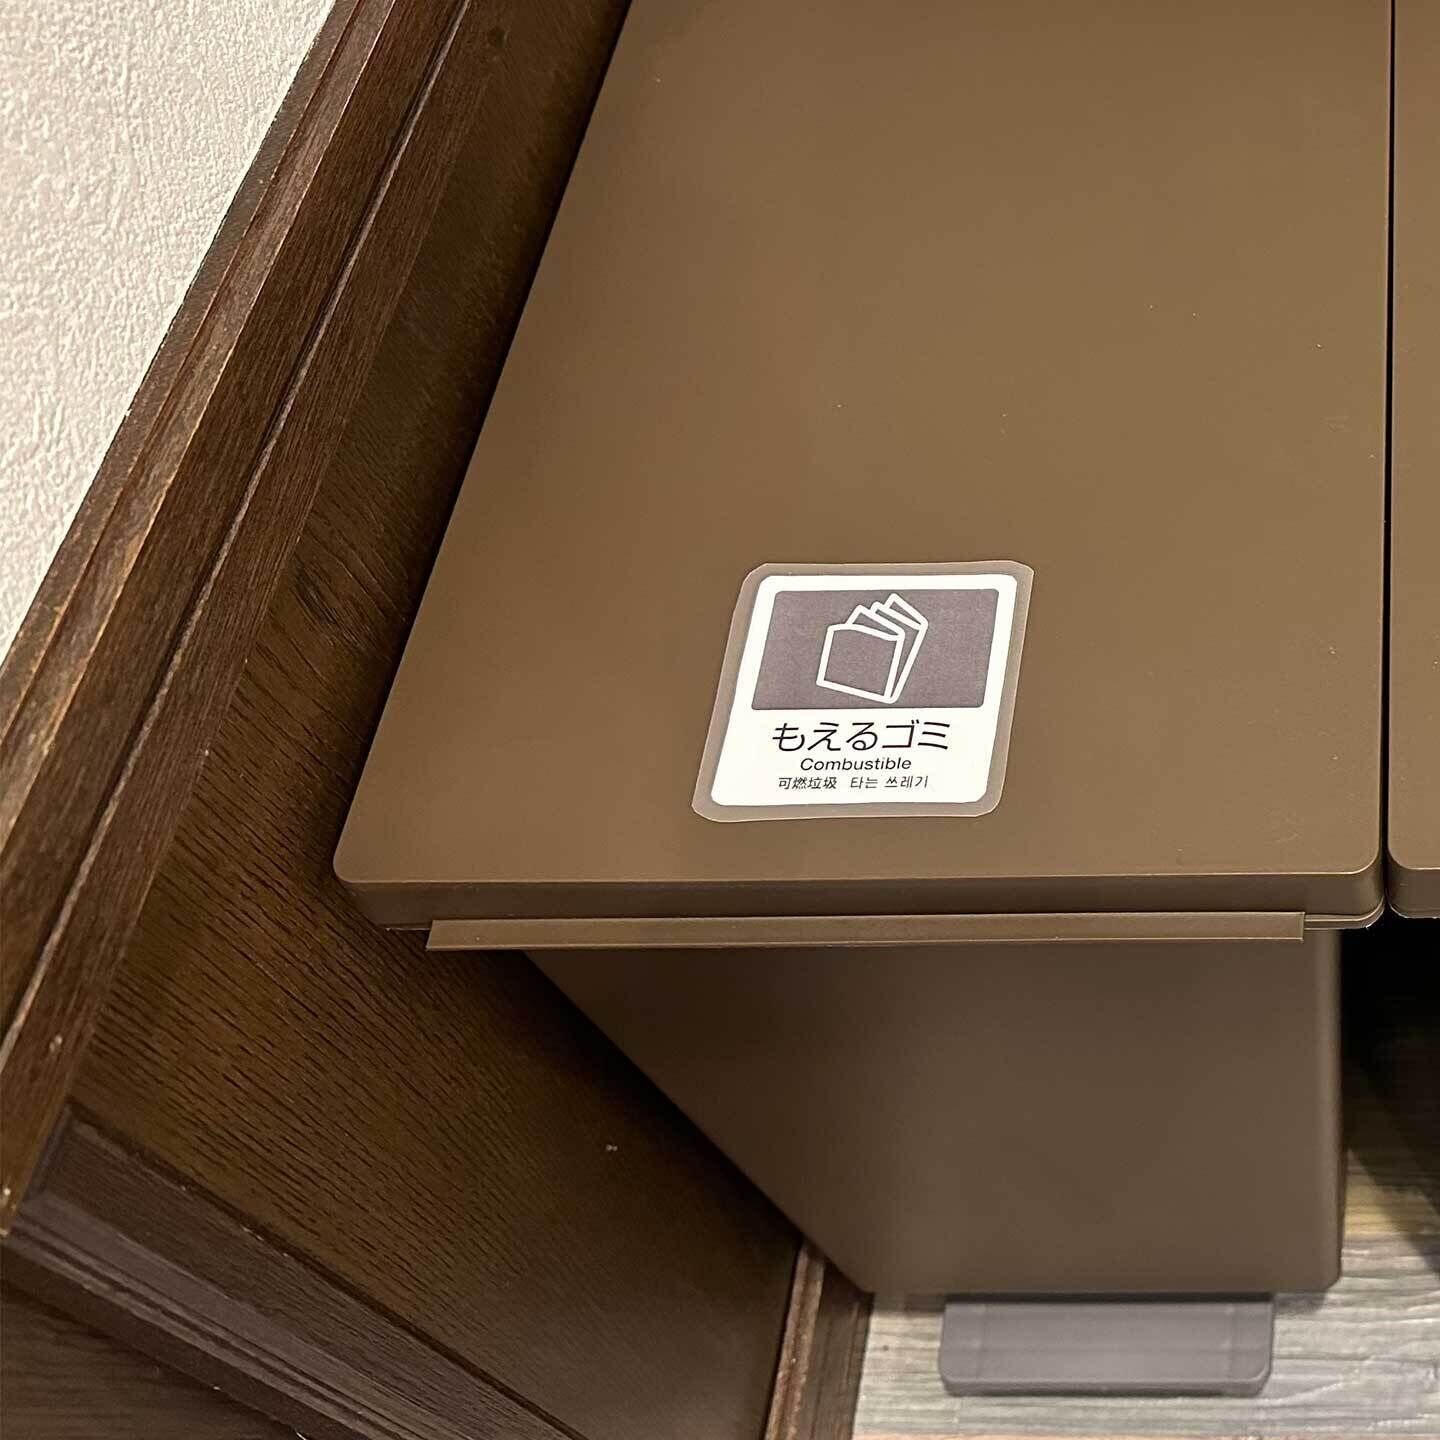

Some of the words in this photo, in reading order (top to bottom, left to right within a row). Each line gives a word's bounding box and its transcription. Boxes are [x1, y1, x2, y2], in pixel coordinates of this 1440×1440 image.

[772, 719, 950, 751] もえるゴミ
[800, 757, 912, 771] Combustible
[778, 776, 837, 790] 可燃垃圾
[850, 776, 879, 789] 타는
[884, 775, 929, 788] 쓰레기
